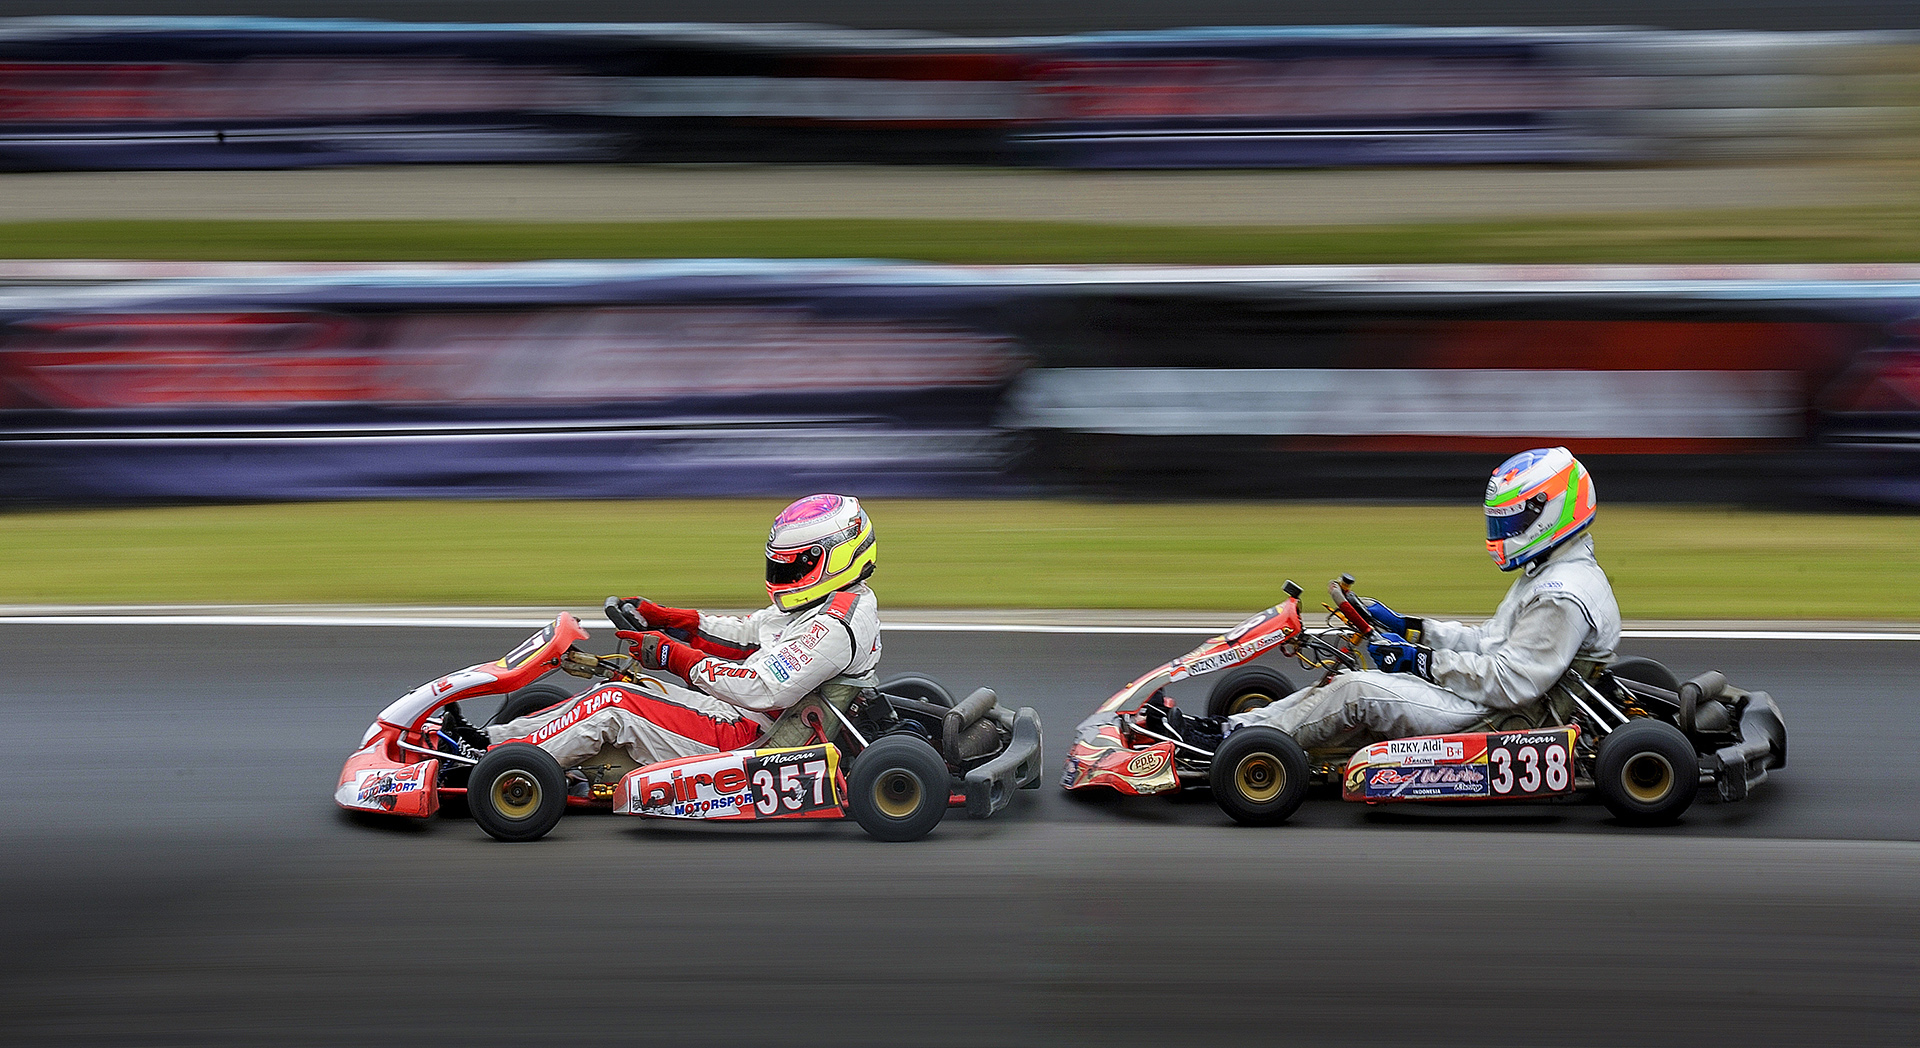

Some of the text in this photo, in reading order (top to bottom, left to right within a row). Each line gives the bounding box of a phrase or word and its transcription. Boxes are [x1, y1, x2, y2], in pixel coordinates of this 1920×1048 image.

[788, 640, 813, 666] birel
[531, 690, 623, 743] TOMMY TANG
[1390, 739, 1442, 754] RIZKY, Aldi
[1500, 733, 1557, 746] Macau
[760, 751, 816, 766] Macau
[1490, 743, 1569, 794] 338
[752, 759, 827, 815] 357
